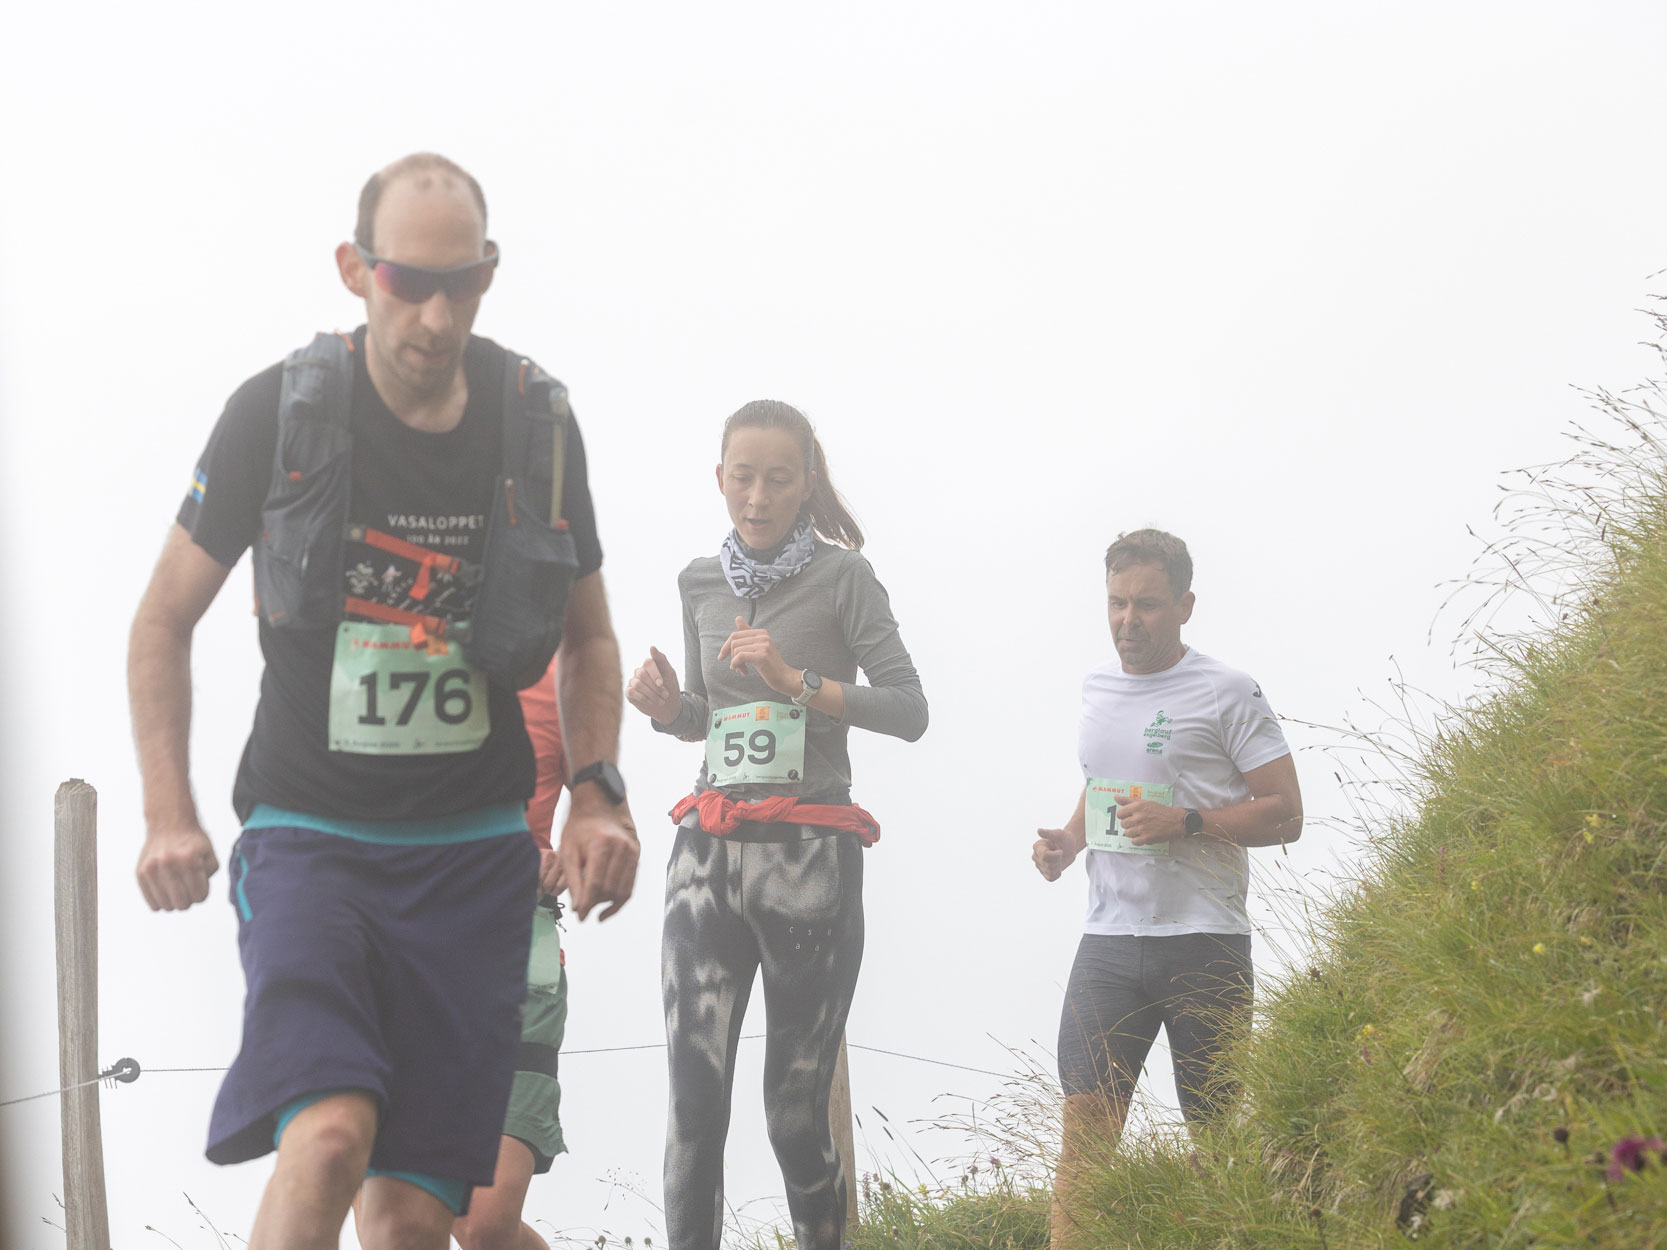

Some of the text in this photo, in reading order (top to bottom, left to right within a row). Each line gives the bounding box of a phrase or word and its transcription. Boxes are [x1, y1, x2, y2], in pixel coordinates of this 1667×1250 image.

[387, 513, 484, 530] VASALOPPET
[358, 668, 472, 726] 176
[723, 711, 750, 722] MAMMUT
[723, 729, 776, 767] 59
[1105, 804, 1126, 836] 1
